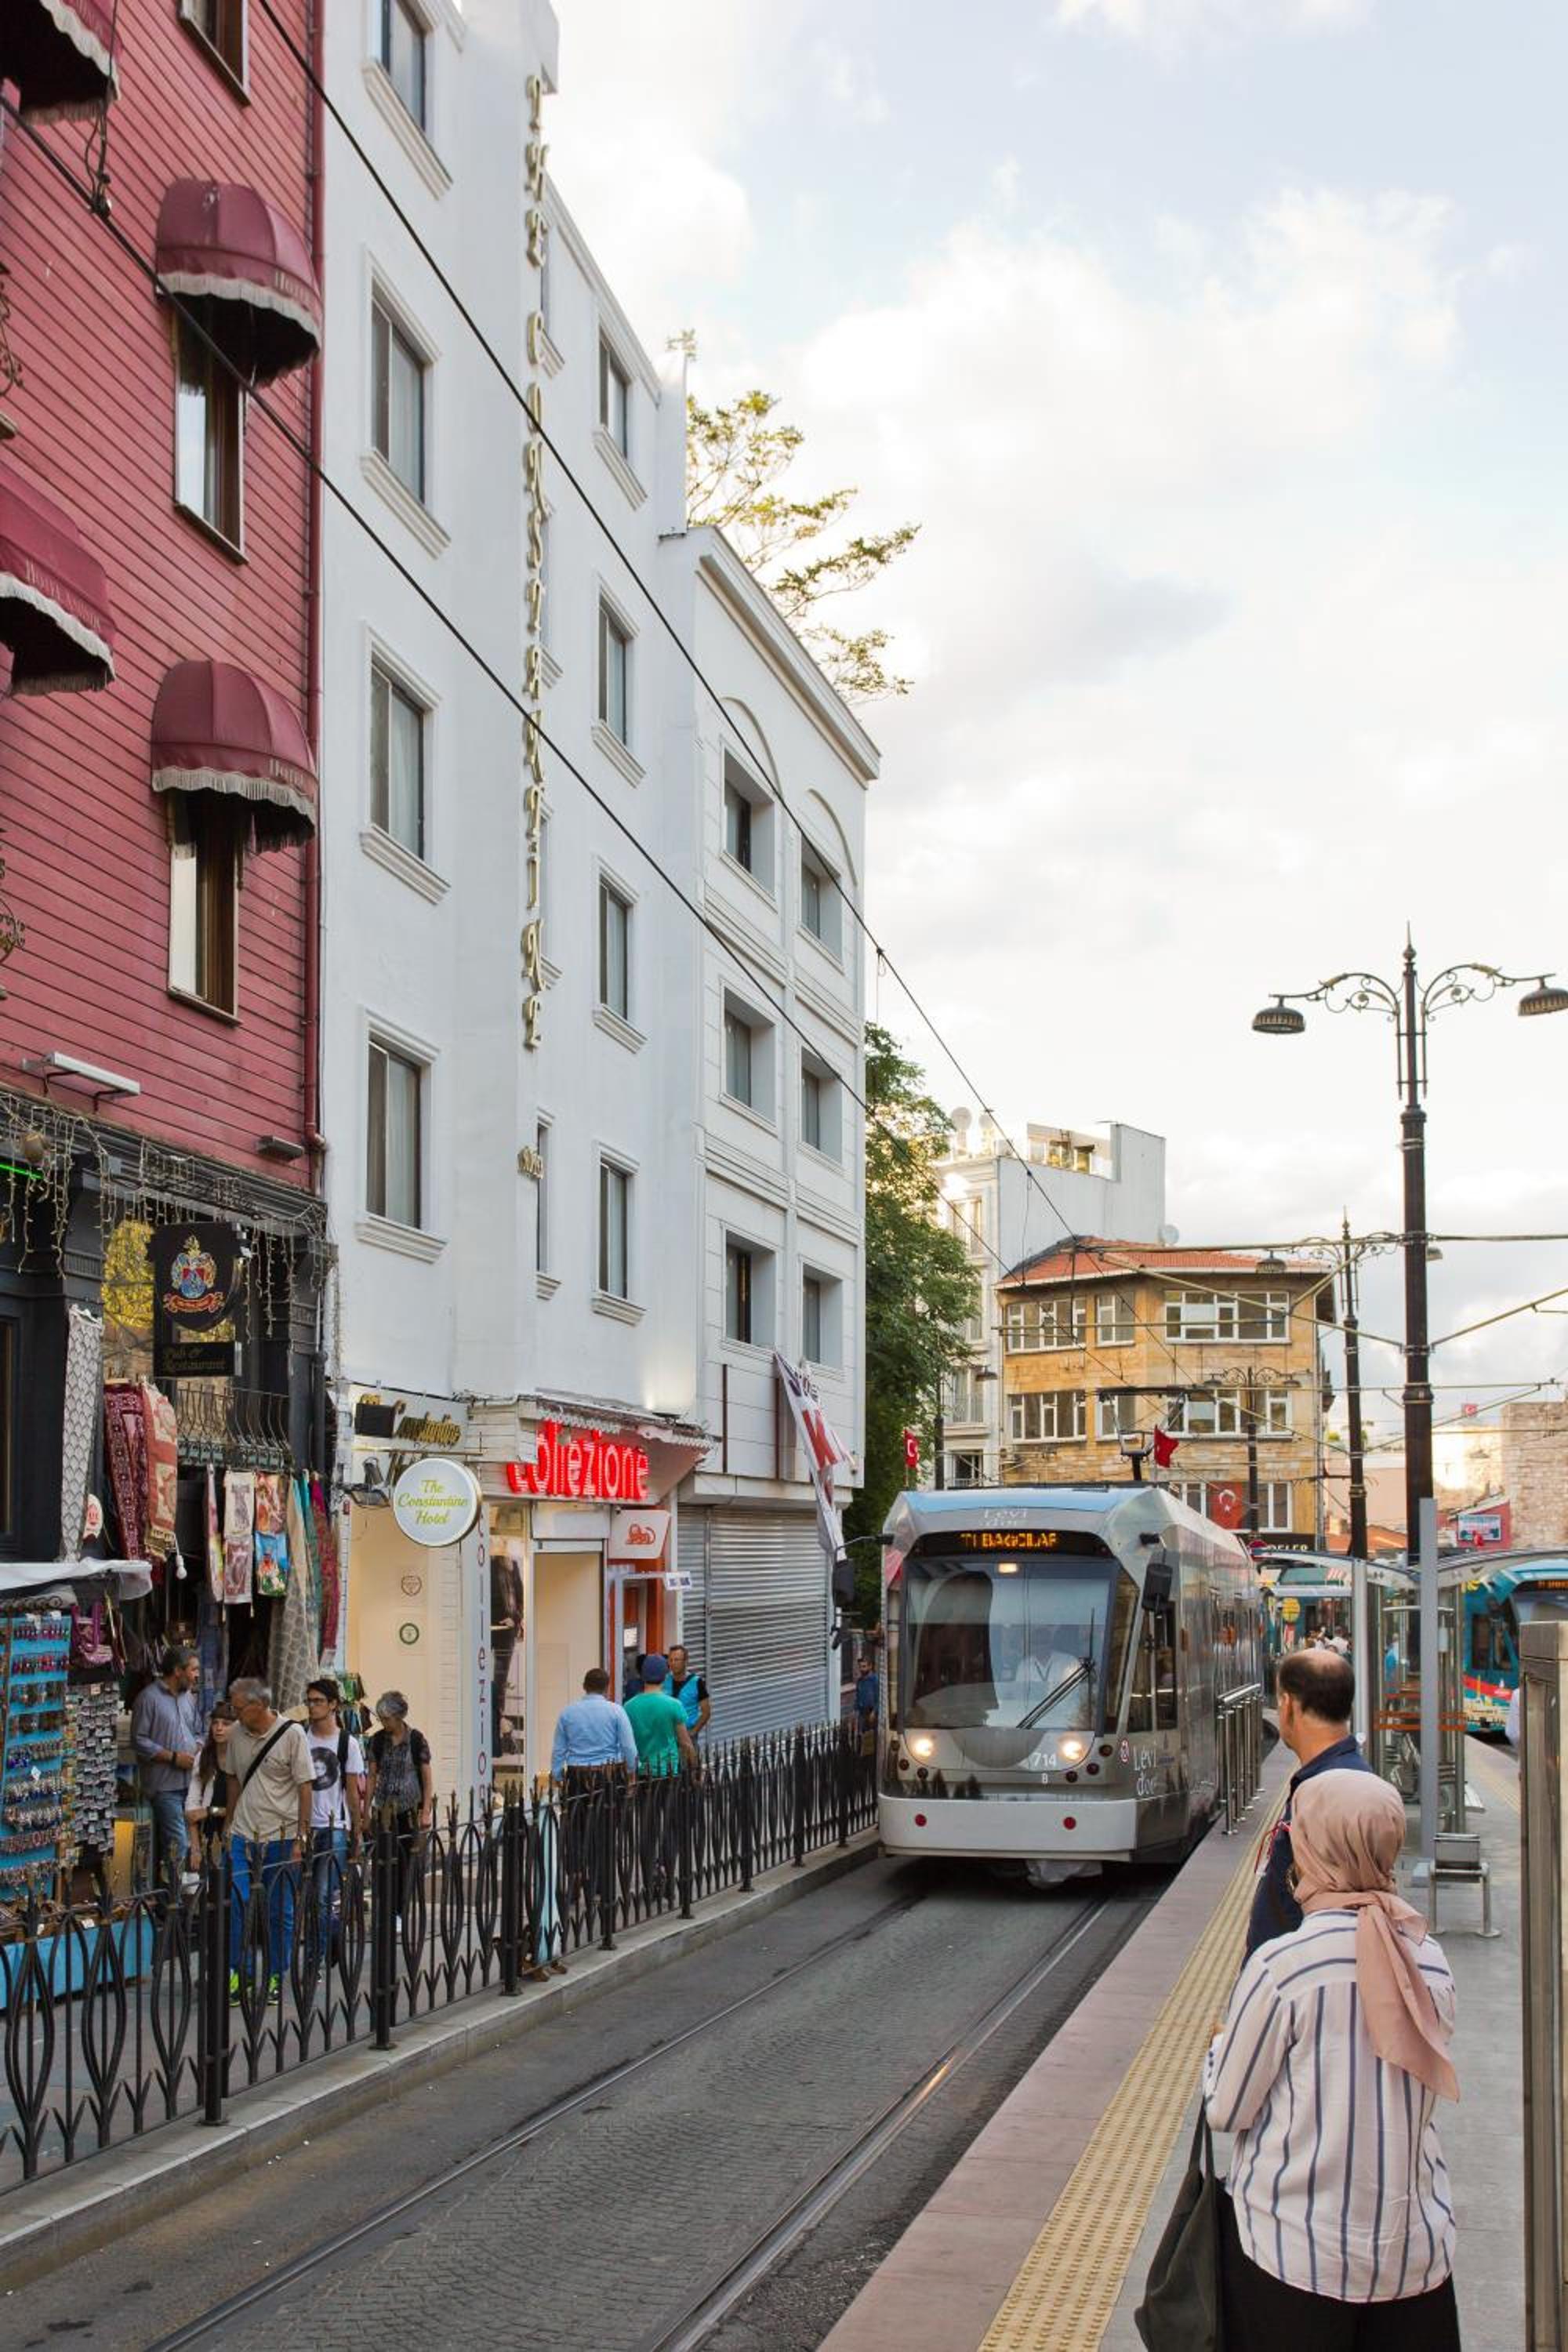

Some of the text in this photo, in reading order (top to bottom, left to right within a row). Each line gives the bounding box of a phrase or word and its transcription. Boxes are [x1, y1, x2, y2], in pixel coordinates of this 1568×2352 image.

[420, 1479, 445, 1494] The
[397, 1493, 469, 1508] Constantine
[416, 1509, 450, 1525] Hotel
